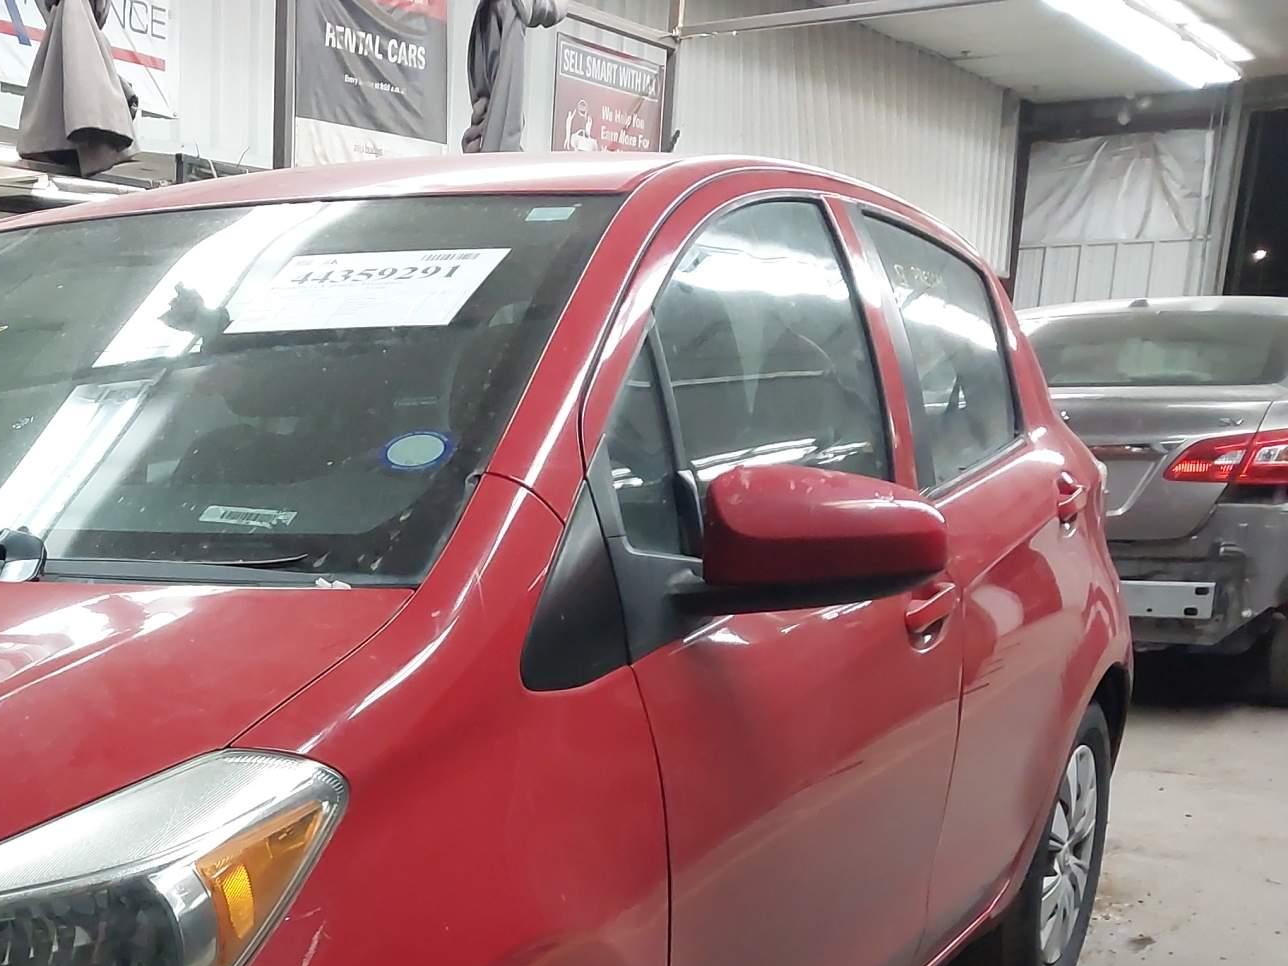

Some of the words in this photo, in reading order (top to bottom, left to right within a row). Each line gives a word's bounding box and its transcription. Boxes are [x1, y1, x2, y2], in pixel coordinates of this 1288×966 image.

[324, 22, 383, 60] RENTAL
[386, 38, 427, 70] CARS
[563, 49, 584, 75] SELL
[586, 56, 617, 84] SMART
[619, 66, 642, 92] WITH
[631, 112, 646, 130] You
[618, 129, 638, 148] More
[638, 134, 651, 149] For
[290, 264, 463, 285] 44359291
